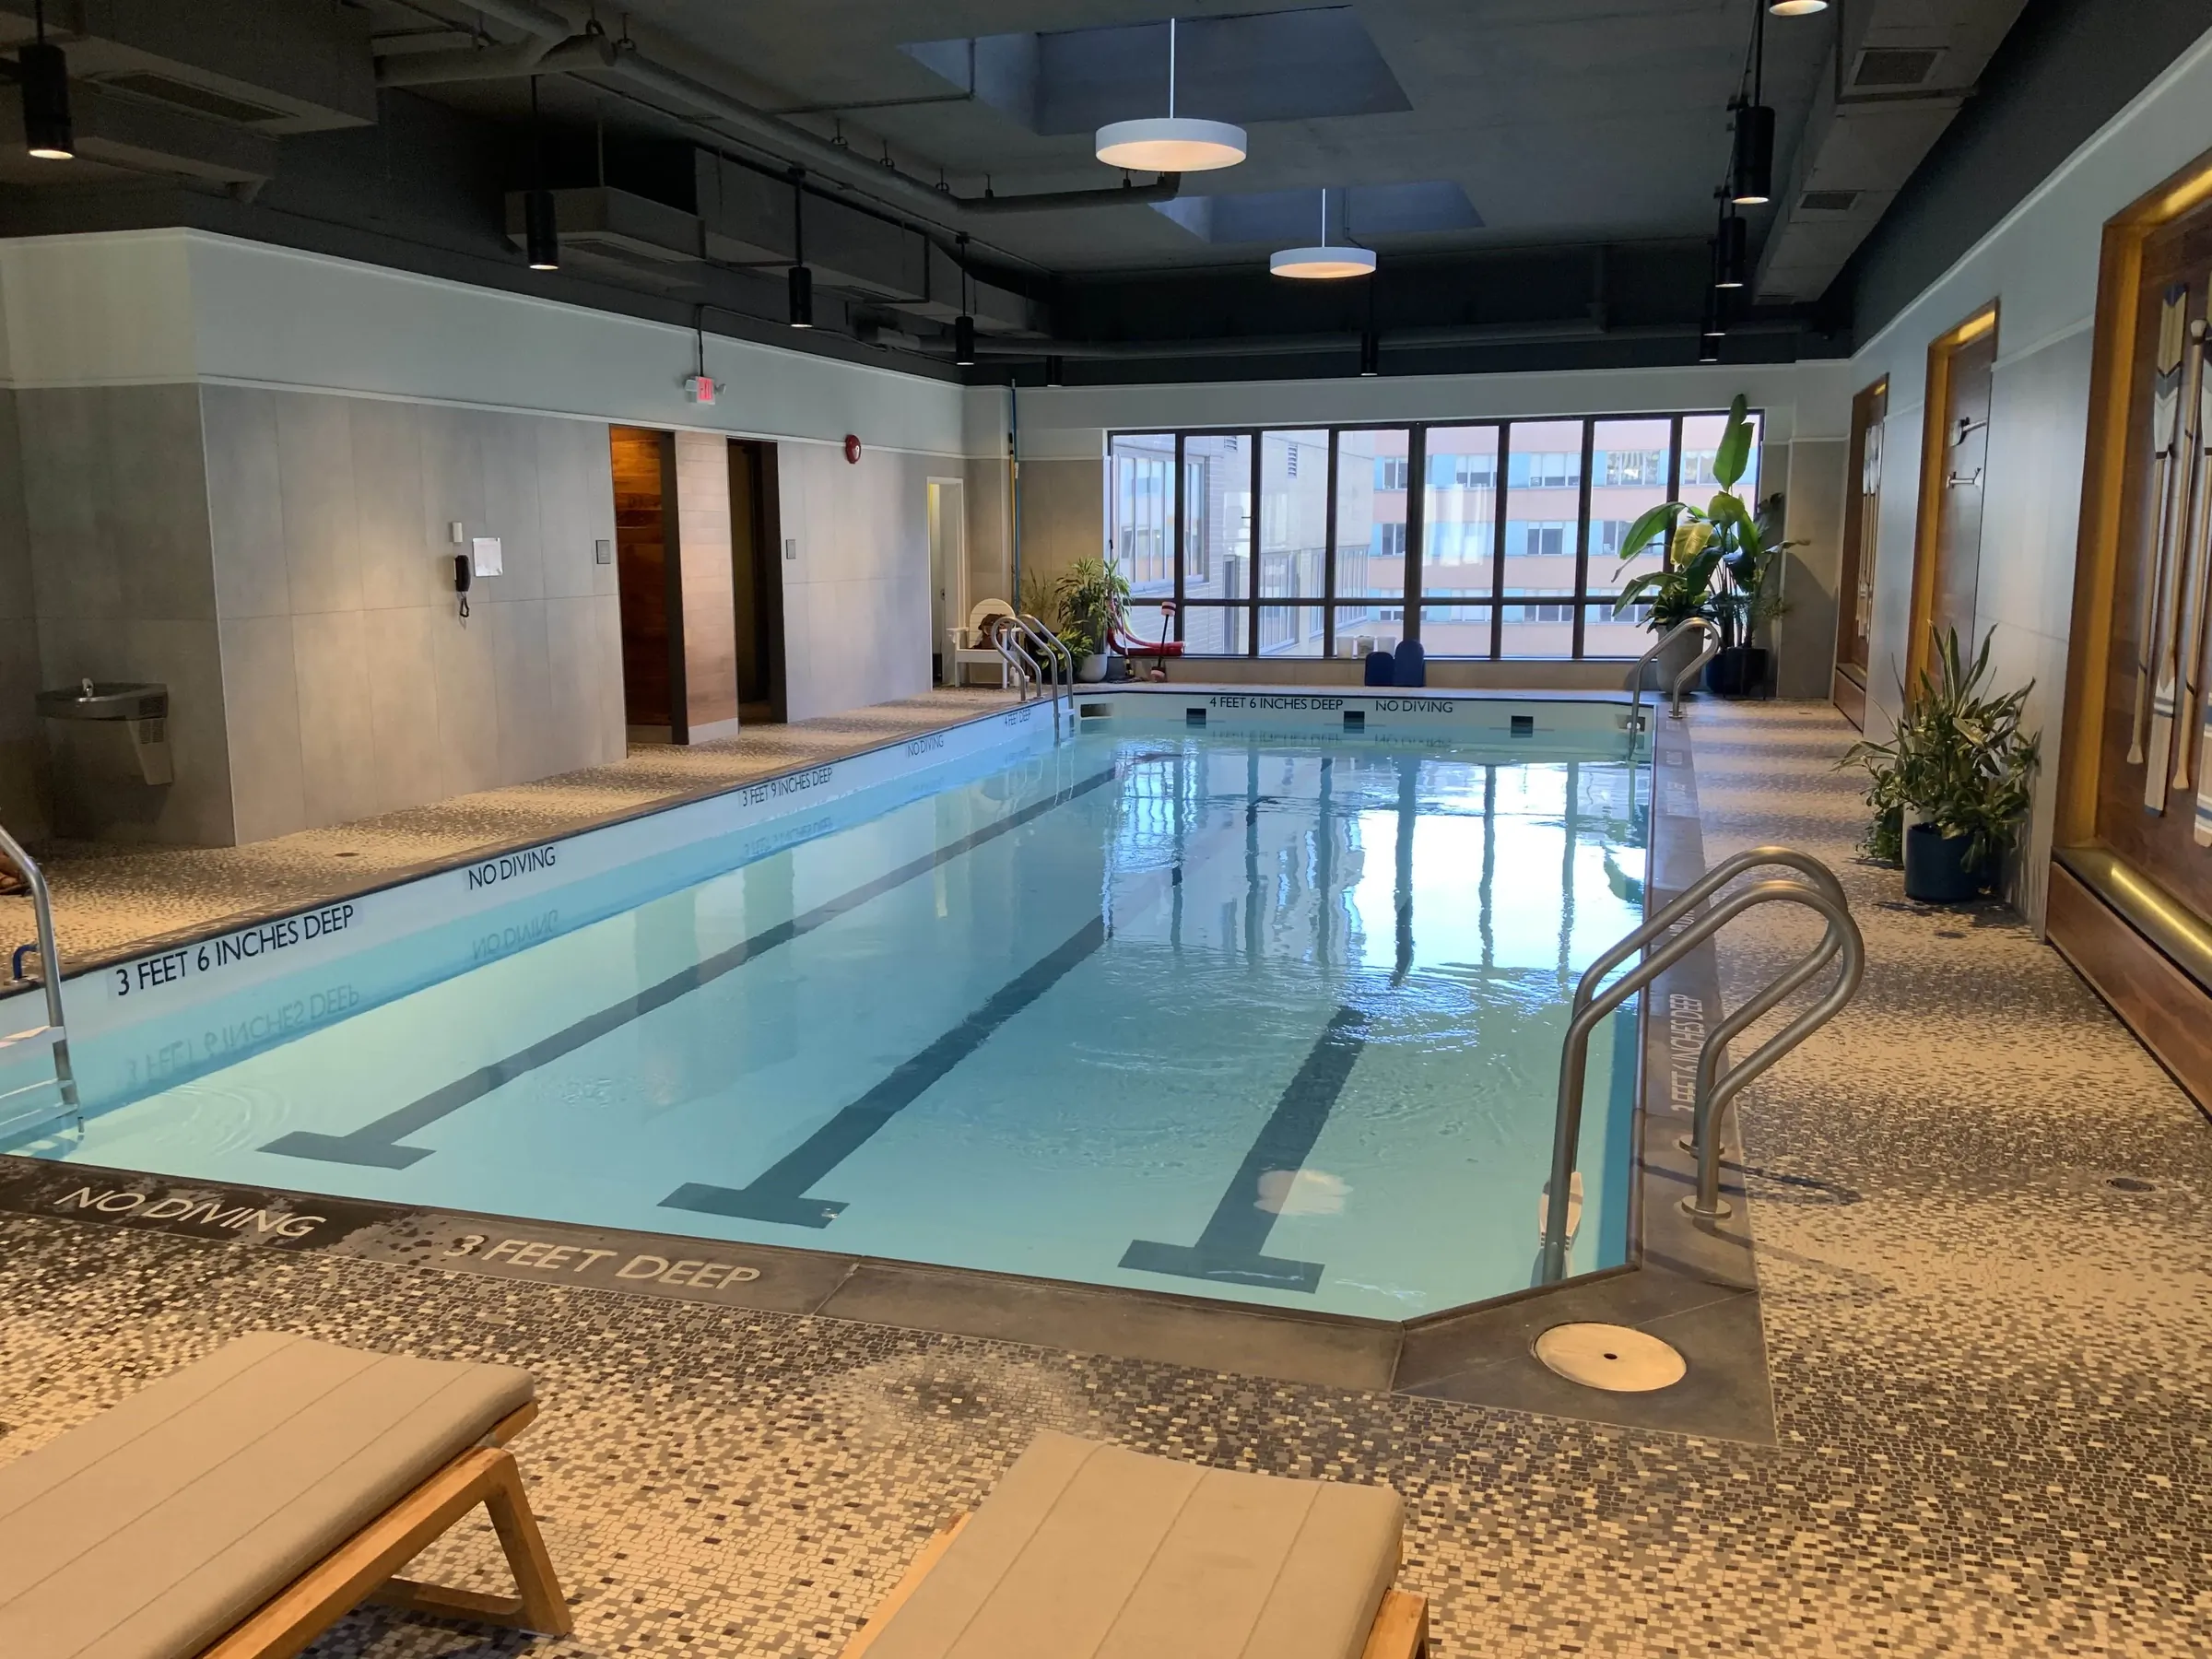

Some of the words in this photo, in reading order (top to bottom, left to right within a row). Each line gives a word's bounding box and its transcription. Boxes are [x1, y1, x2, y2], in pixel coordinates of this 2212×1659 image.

[1007, 712, 1018, 726] FEET
[1019, 708, 1031, 723] DEEP
[1209, 698, 1217, 708] 4
[1220, 697, 1246, 708] FEET
[1249, 698, 1257, 709] 6
[1260, 699, 1307, 710] INCHES
[1311, 699, 1343, 711] DEEP
[1375, 700, 1398, 712] NO
[1402, 700, 1453, 713] DIVING
[907, 741, 920, 758] NO
[921, 735, 944, 753] DIVING
[742, 791, 748, 806] 3
[750, 784, 769, 806] FEET
[771, 782, 777, 798] 9
[778, 772, 811, 796] INCHES
[812, 767, 833, 786] DEEP
[468, 864, 497, 890] NO
[500, 846, 556, 880] DIVING
[116, 969, 130, 996] 3
[137, 951, 187, 990] FEET
[197, 946, 210, 971] 6
[216, 921, 299, 966] INCHES
[304, 904, 354, 940] DEEP
[1669, 994, 1703, 1020] DEEP
[1670, 1019, 1705, 1063] INCHES
[53, 1186, 146, 1212] NO
[141, 1197, 327, 1237] DIVING
[442, 1234, 485, 1257] 3
[481, 1239, 618, 1272] FEET
[615, 1254, 761, 1289] DEEP
